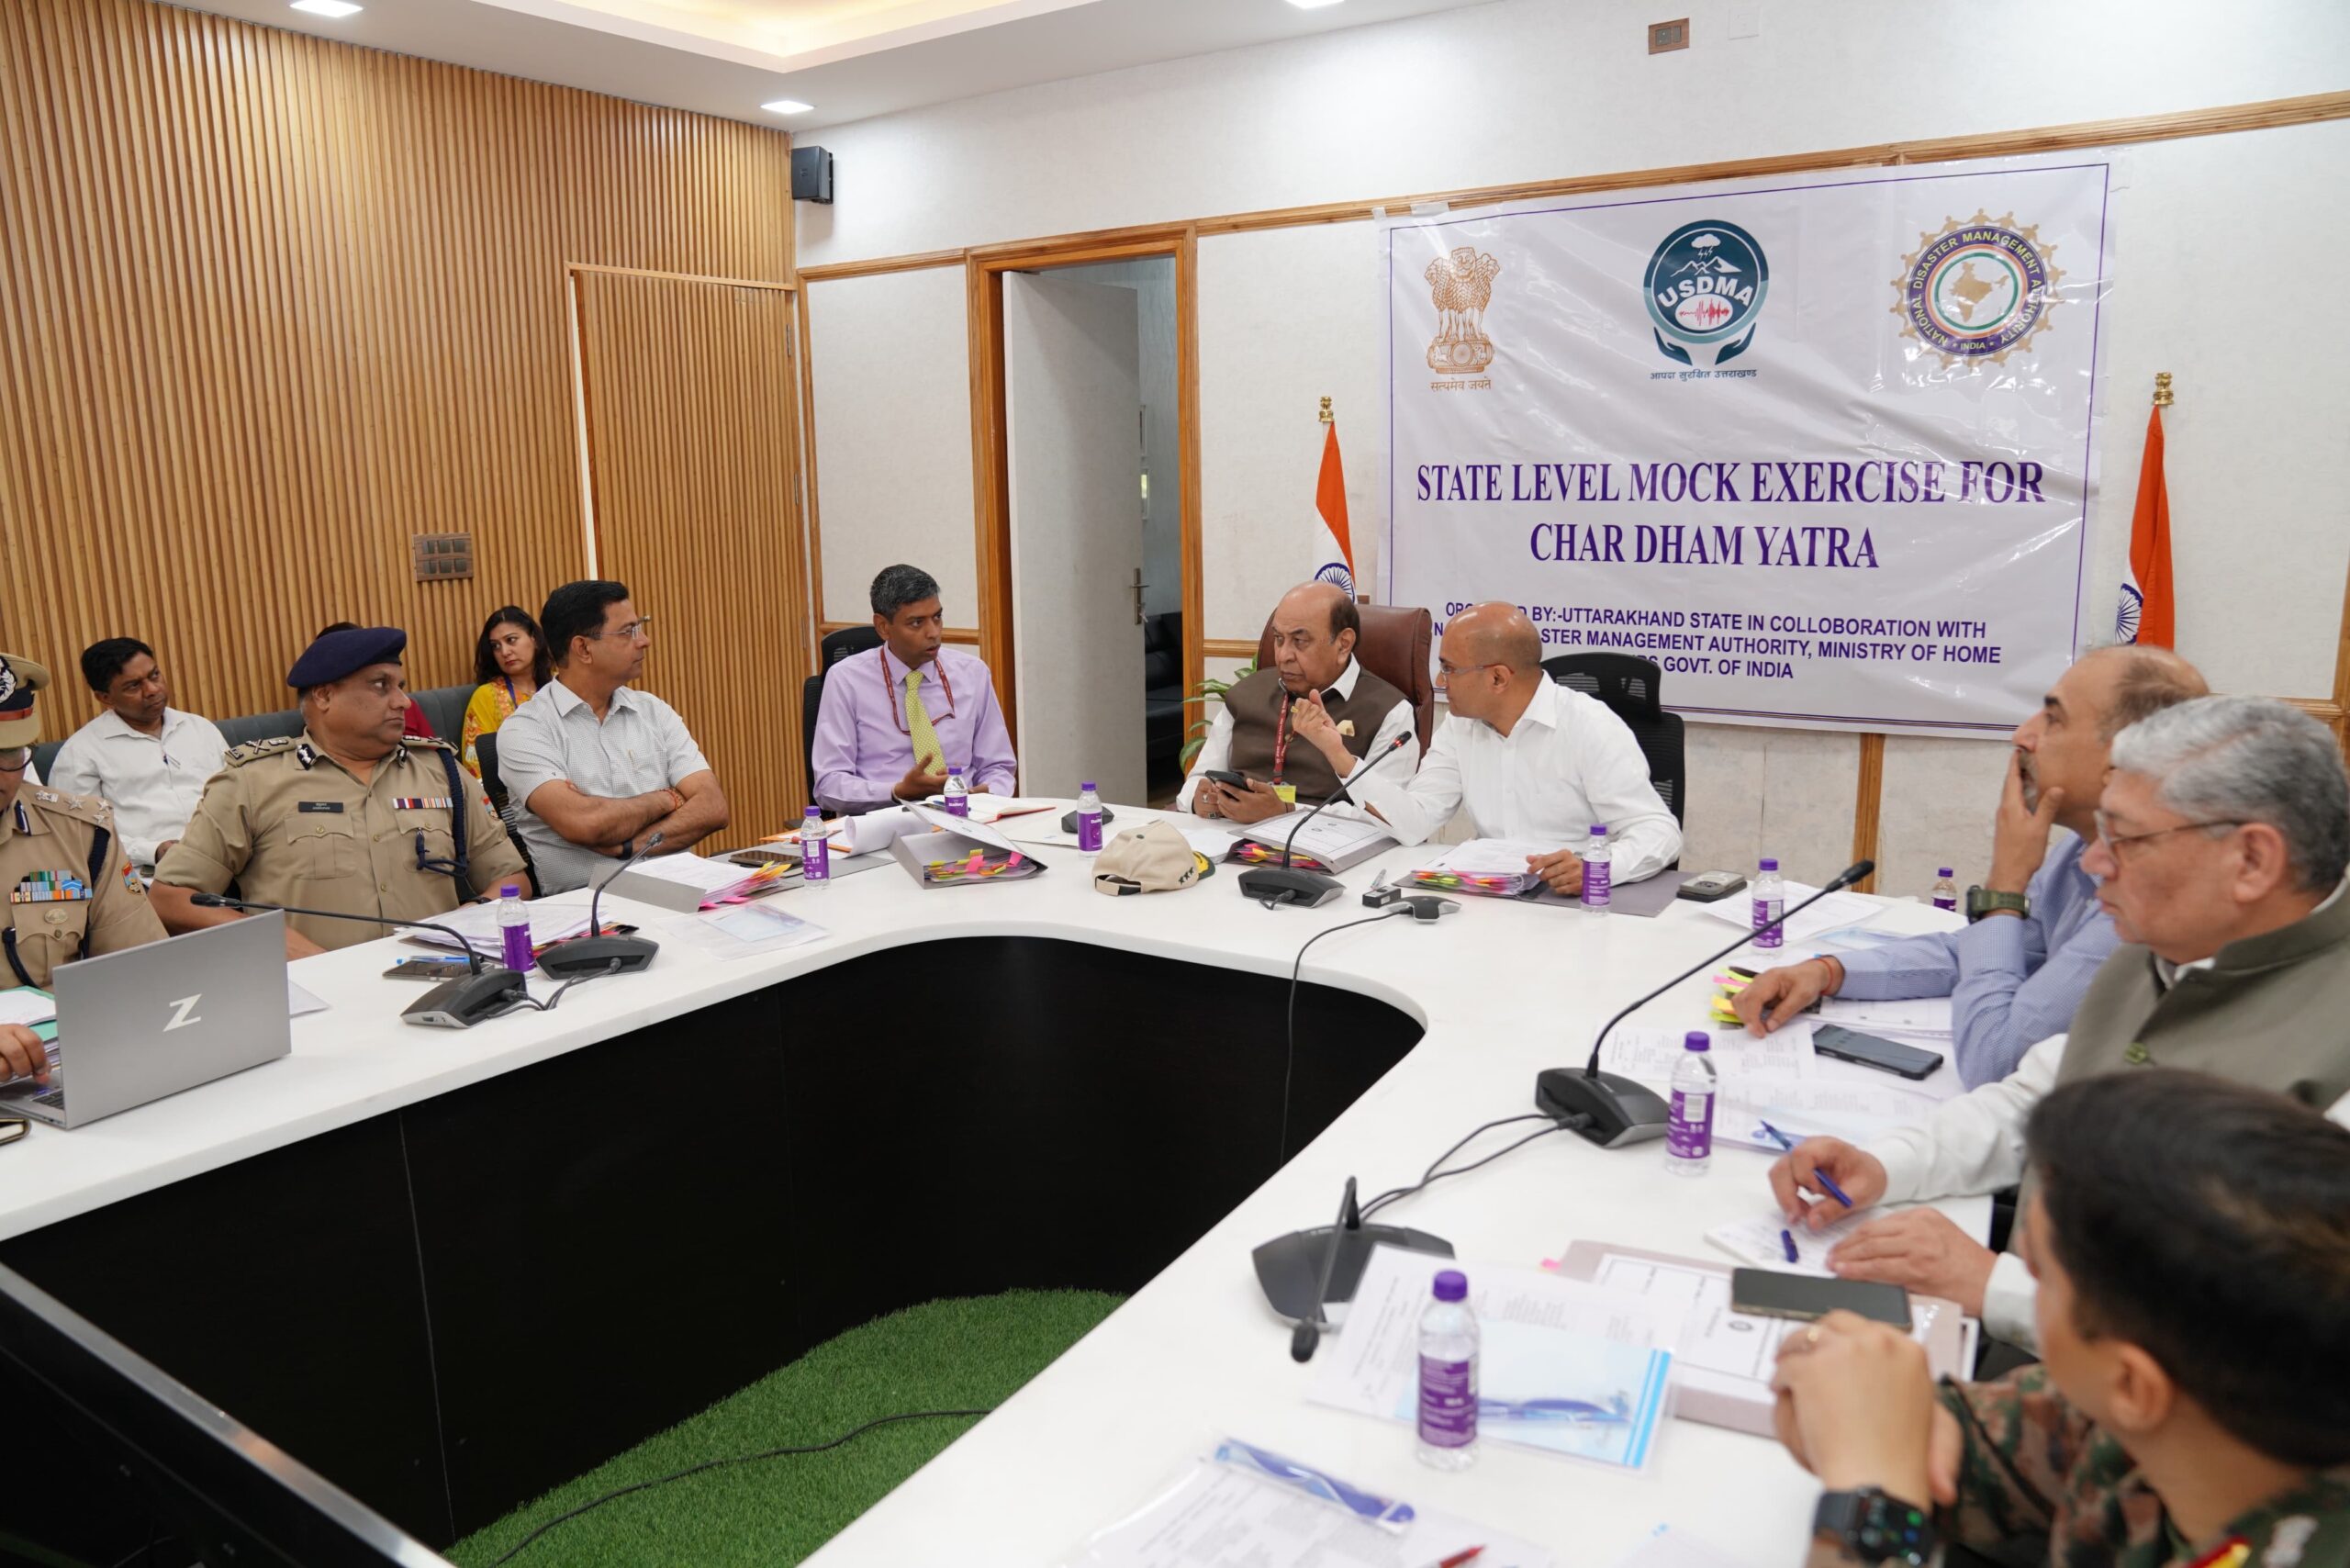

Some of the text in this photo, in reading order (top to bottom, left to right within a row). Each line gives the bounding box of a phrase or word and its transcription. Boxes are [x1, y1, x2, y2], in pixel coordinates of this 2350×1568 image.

[1657, 276, 1753, 308] USDMA
[1913, 231, 2042, 346] NATIONAL DISASTER MANAGEMENT AUTHORITY
[1960, 342, 1986, 351] INDIA
[1417, 461, 2047, 504] STATE LEVEL MOCK EXERCISE FOR
[1529, 522, 1880, 568] CHAR DHAM YATRA
[1690, 612, 1742, 631] STATE
[1747, 614, 1765, 632] IN
[1770, 615, 1930, 637] COLLOBORATION
[1937, 621, 1986, 639] WITH
[1540, 628, 2002, 664] STER MANAGEMENT AUTHORITY, MINISTRY OF HOME
[1663, 655, 1712, 675] GOVT.
[1718, 658, 1741, 676] OF
[1746, 661, 1795, 679] INDIA
